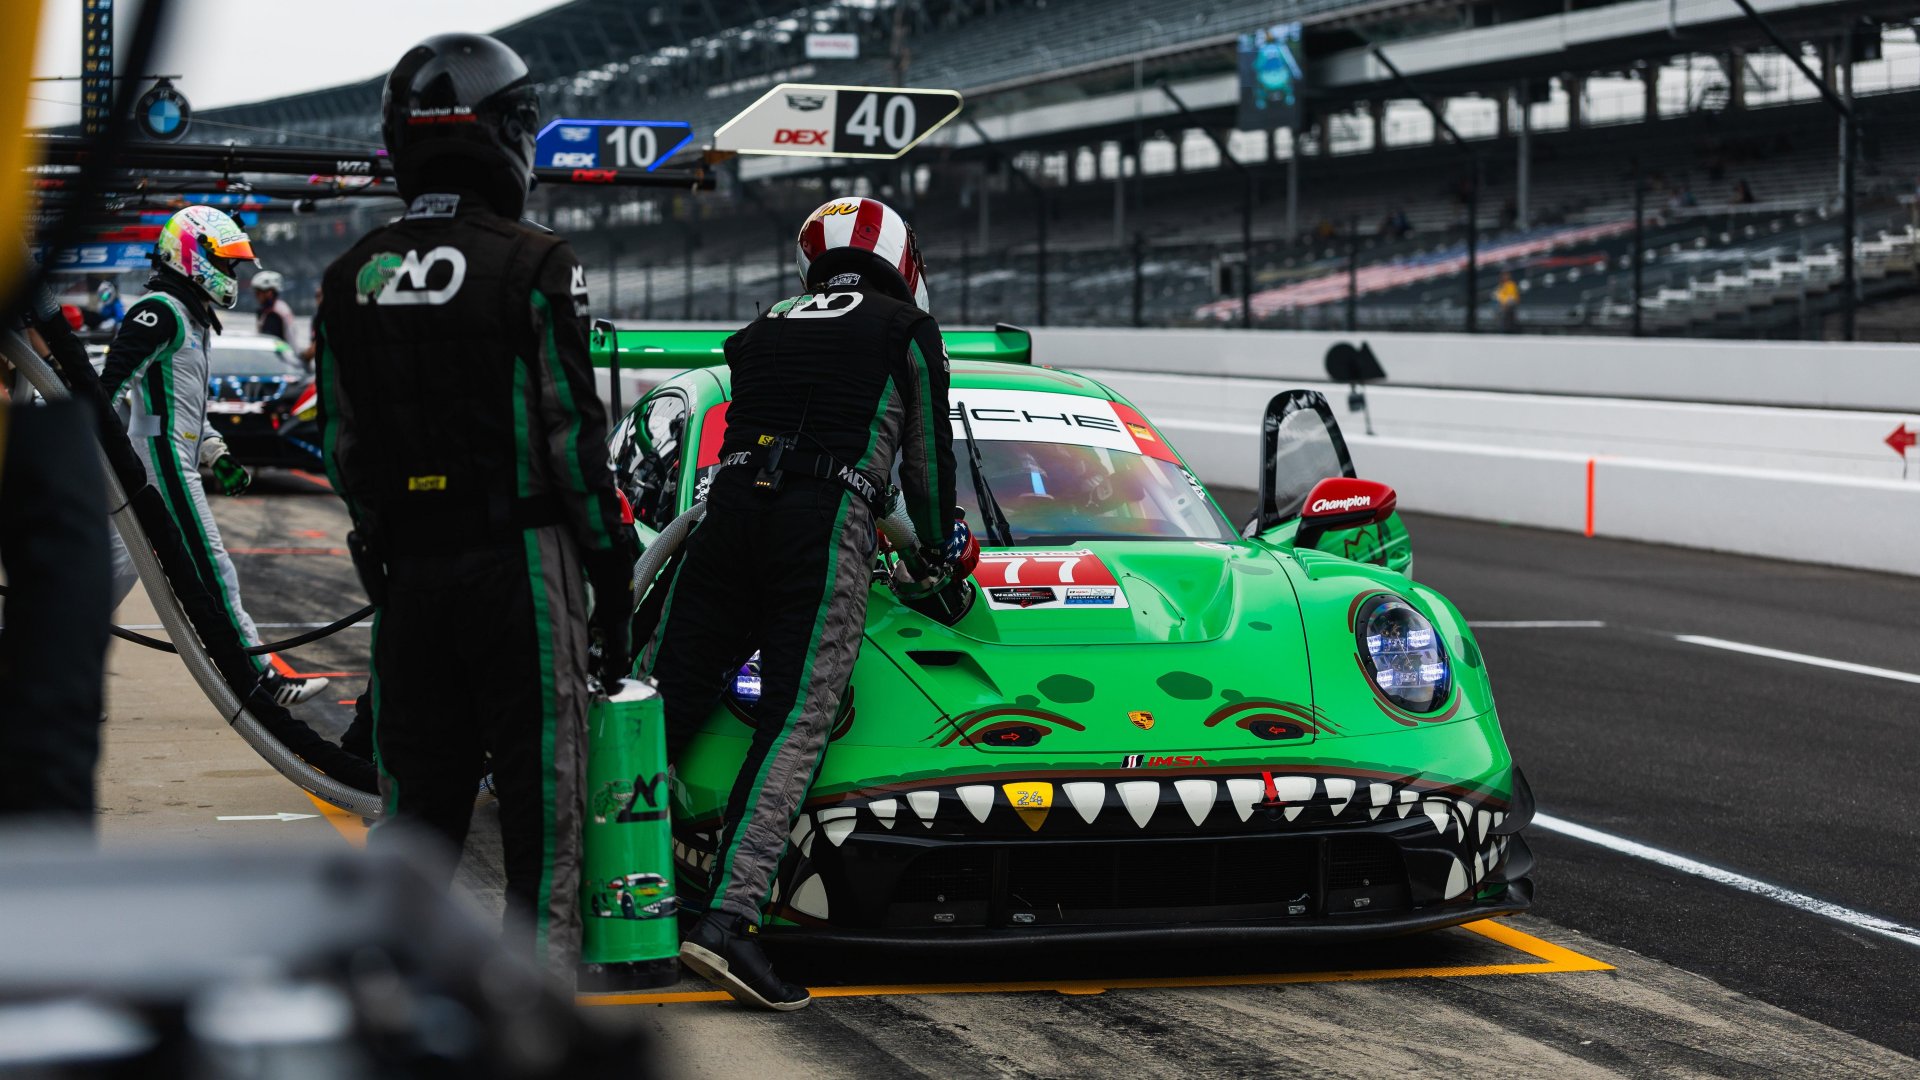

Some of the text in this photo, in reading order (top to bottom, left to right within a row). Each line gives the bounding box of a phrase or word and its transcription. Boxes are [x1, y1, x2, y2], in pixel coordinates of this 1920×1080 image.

[845, 93, 916, 149] 40
[773, 129, 829, 145] DEX
[606, 126, 657, 167] 10
[552, 152, 596, 167] DEX
[571, 169, 618, 182] DEX
[1311, 495, 1371, 513] Champion
[979, 557, 1081, 584] 77
[1147, 755, 1209, 767] IMSA
[1017, 791, 1044, 806] 24
